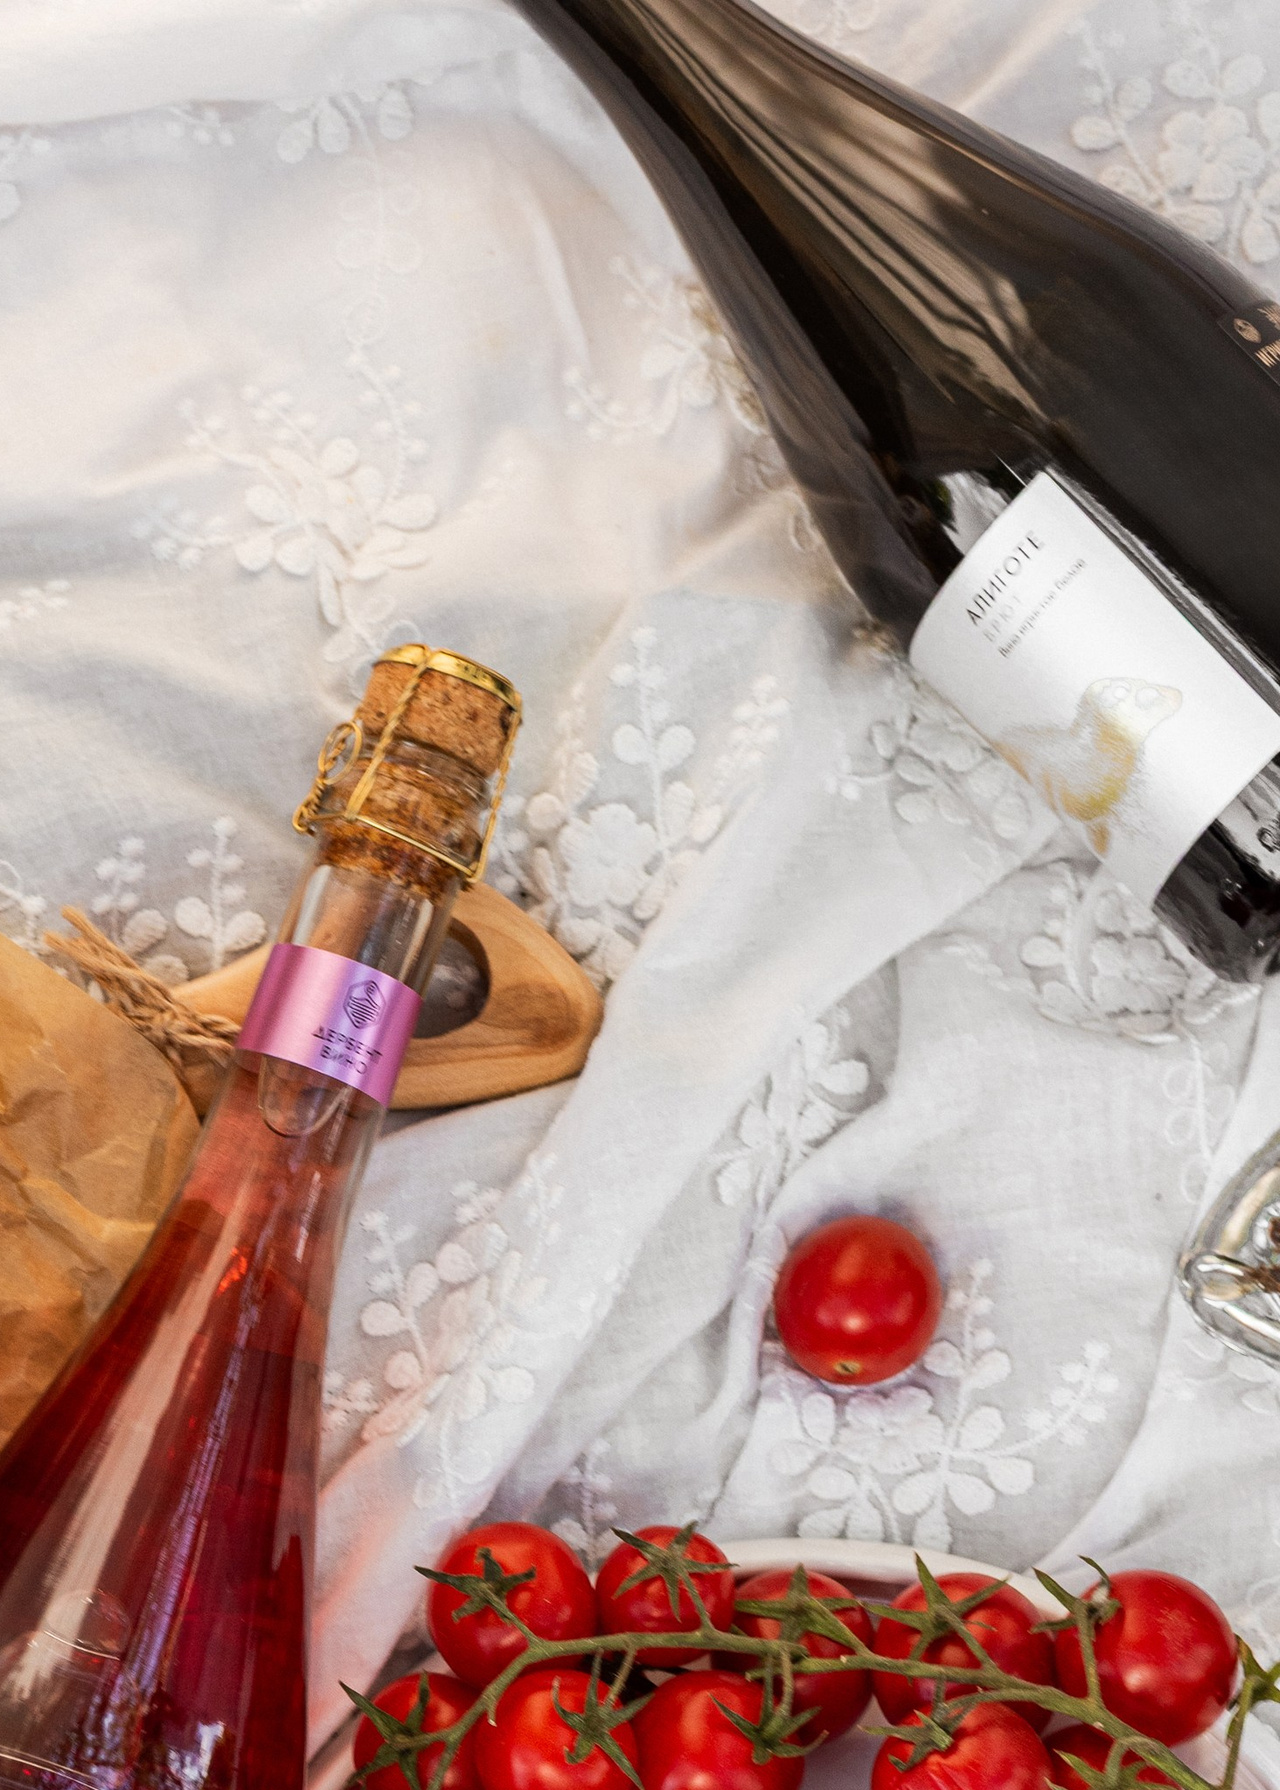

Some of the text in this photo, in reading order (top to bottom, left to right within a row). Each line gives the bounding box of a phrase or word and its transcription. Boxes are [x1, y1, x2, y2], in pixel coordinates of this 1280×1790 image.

[966, 530, 1046, 626] АЛИГОТЕ
[311, 1025, 383, 1064] ДЕРБЕНТ
[320, 1044, 368, 1075] ВИНО
